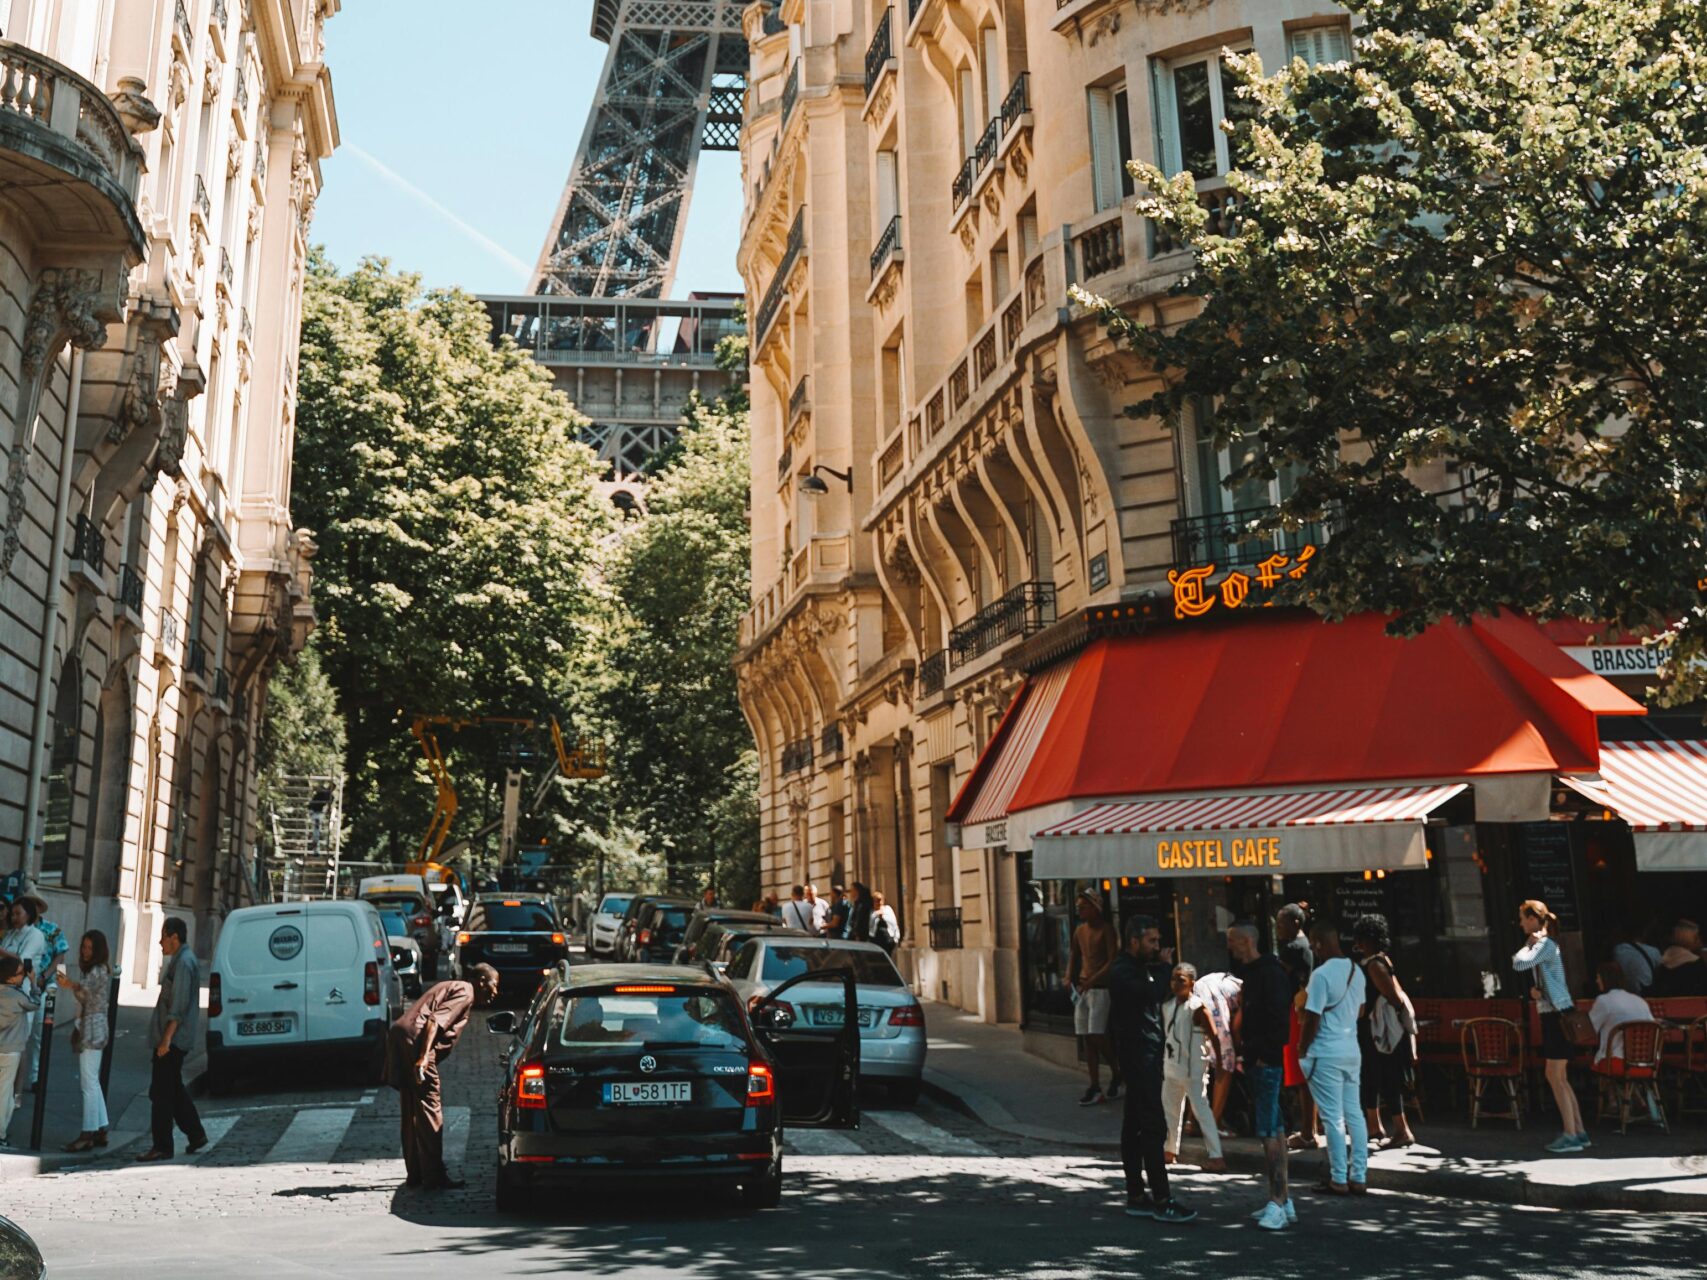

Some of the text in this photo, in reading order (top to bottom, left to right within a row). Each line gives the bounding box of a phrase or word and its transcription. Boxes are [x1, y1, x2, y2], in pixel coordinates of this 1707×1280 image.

[1591, 648, 1674, 671] BRASSER
[1157, 836, 1281, 869] CASTEL CAFE
